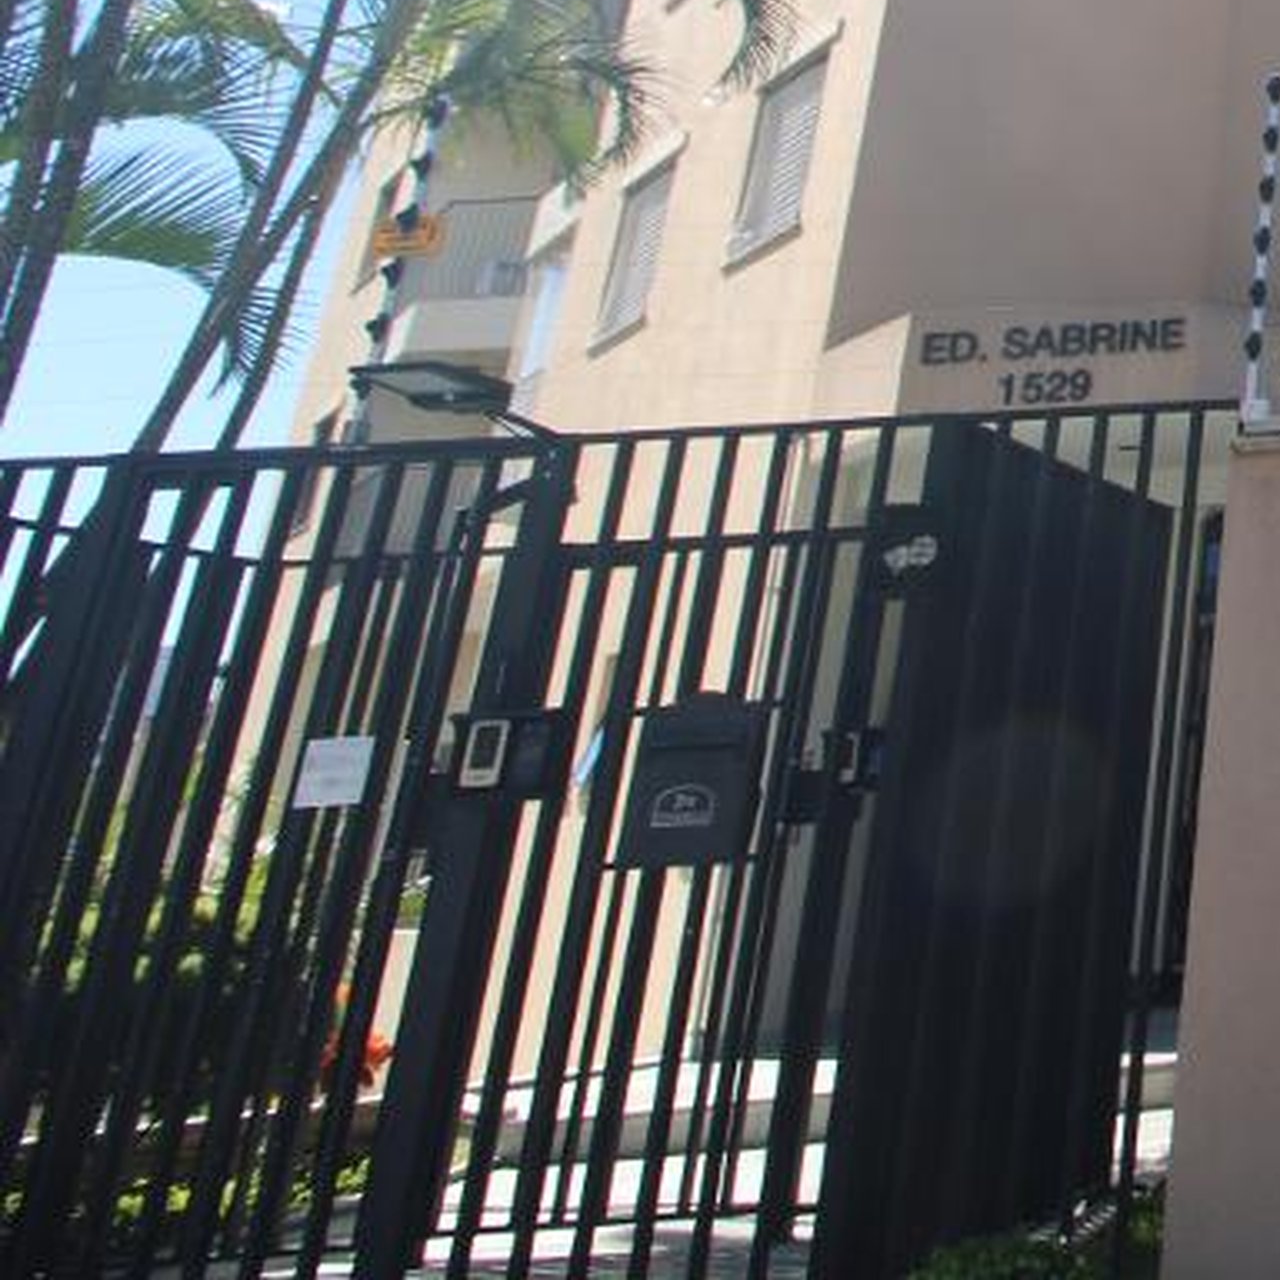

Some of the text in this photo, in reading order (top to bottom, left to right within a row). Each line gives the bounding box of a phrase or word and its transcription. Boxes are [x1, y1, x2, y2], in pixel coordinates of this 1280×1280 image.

[920, 317, 1187, 365] ED. SABRINE
[999, 369, 1092, 406] 1529
